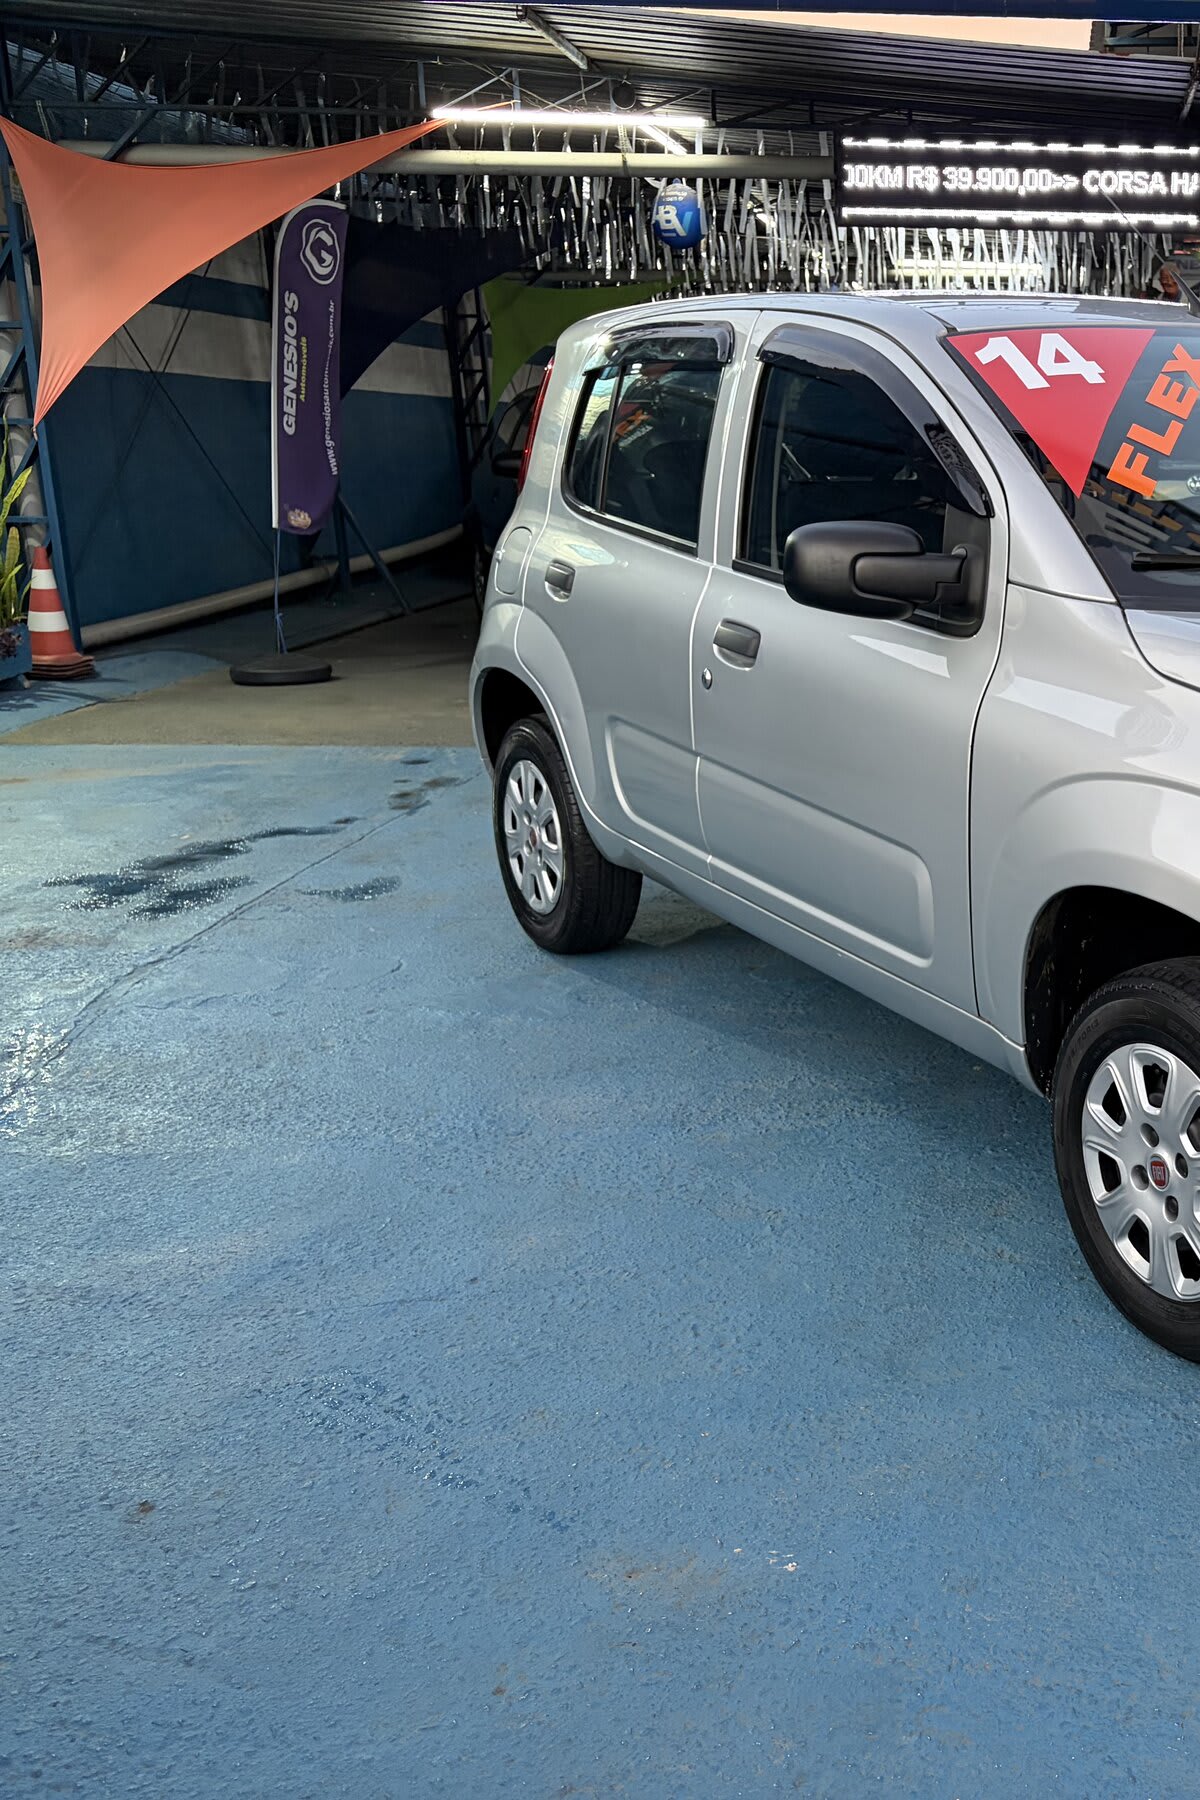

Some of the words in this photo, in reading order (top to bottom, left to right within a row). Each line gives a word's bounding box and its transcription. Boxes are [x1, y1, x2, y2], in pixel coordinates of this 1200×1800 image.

[906, 166, 939, 192] R$
[1082, 169, 1168, 195] CORSA
[283, 290, 299, 436] GENESIO'S
[974, 333, 1106, 390] 14
